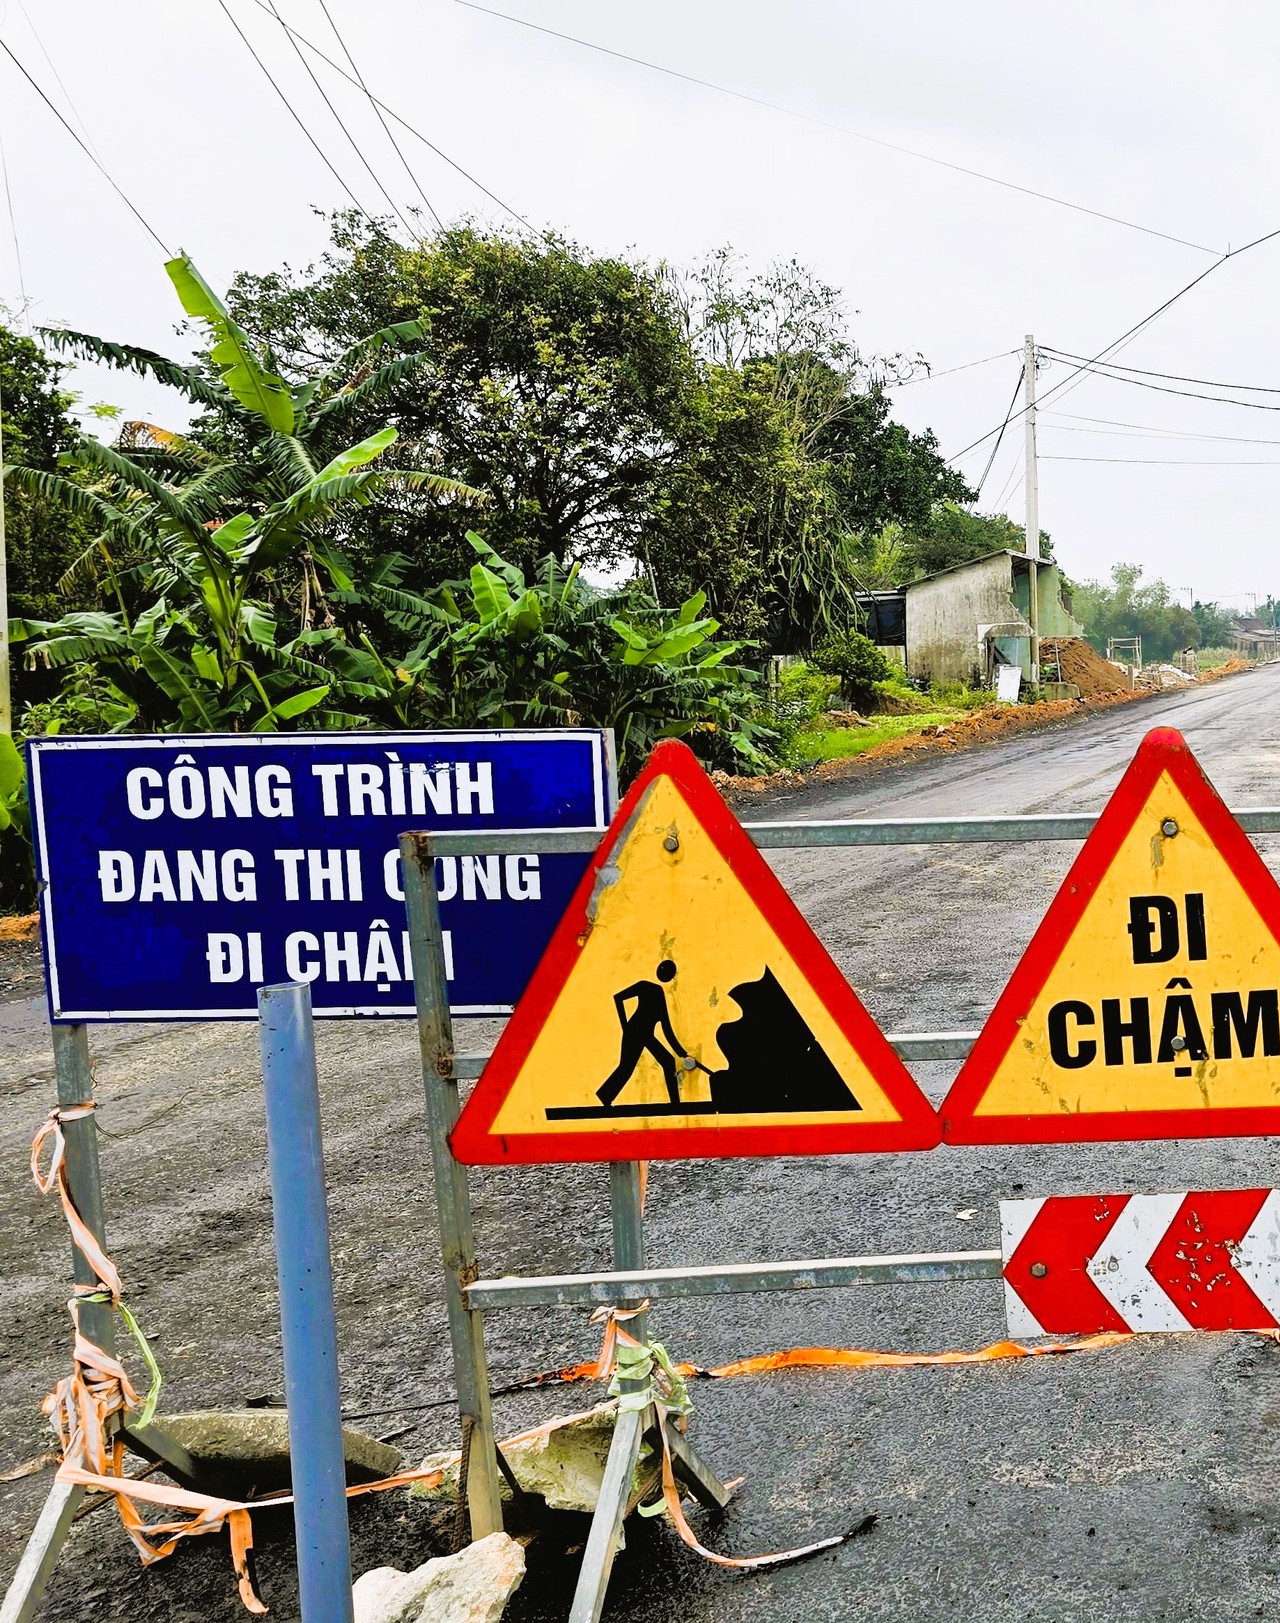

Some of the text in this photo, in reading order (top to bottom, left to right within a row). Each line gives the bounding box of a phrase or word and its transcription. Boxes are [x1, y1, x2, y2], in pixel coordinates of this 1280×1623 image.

[126, 752, 494, 820] CÔNG TRÌNH
[98, 850, 258, 902] ĐANG
[275, 849, 363, 901] THI
[206, 932, 263, 983] ĐI
[1127, 893, 1207, 964] ĐI
[1048, 977, 1280, 1077] CHẬM
